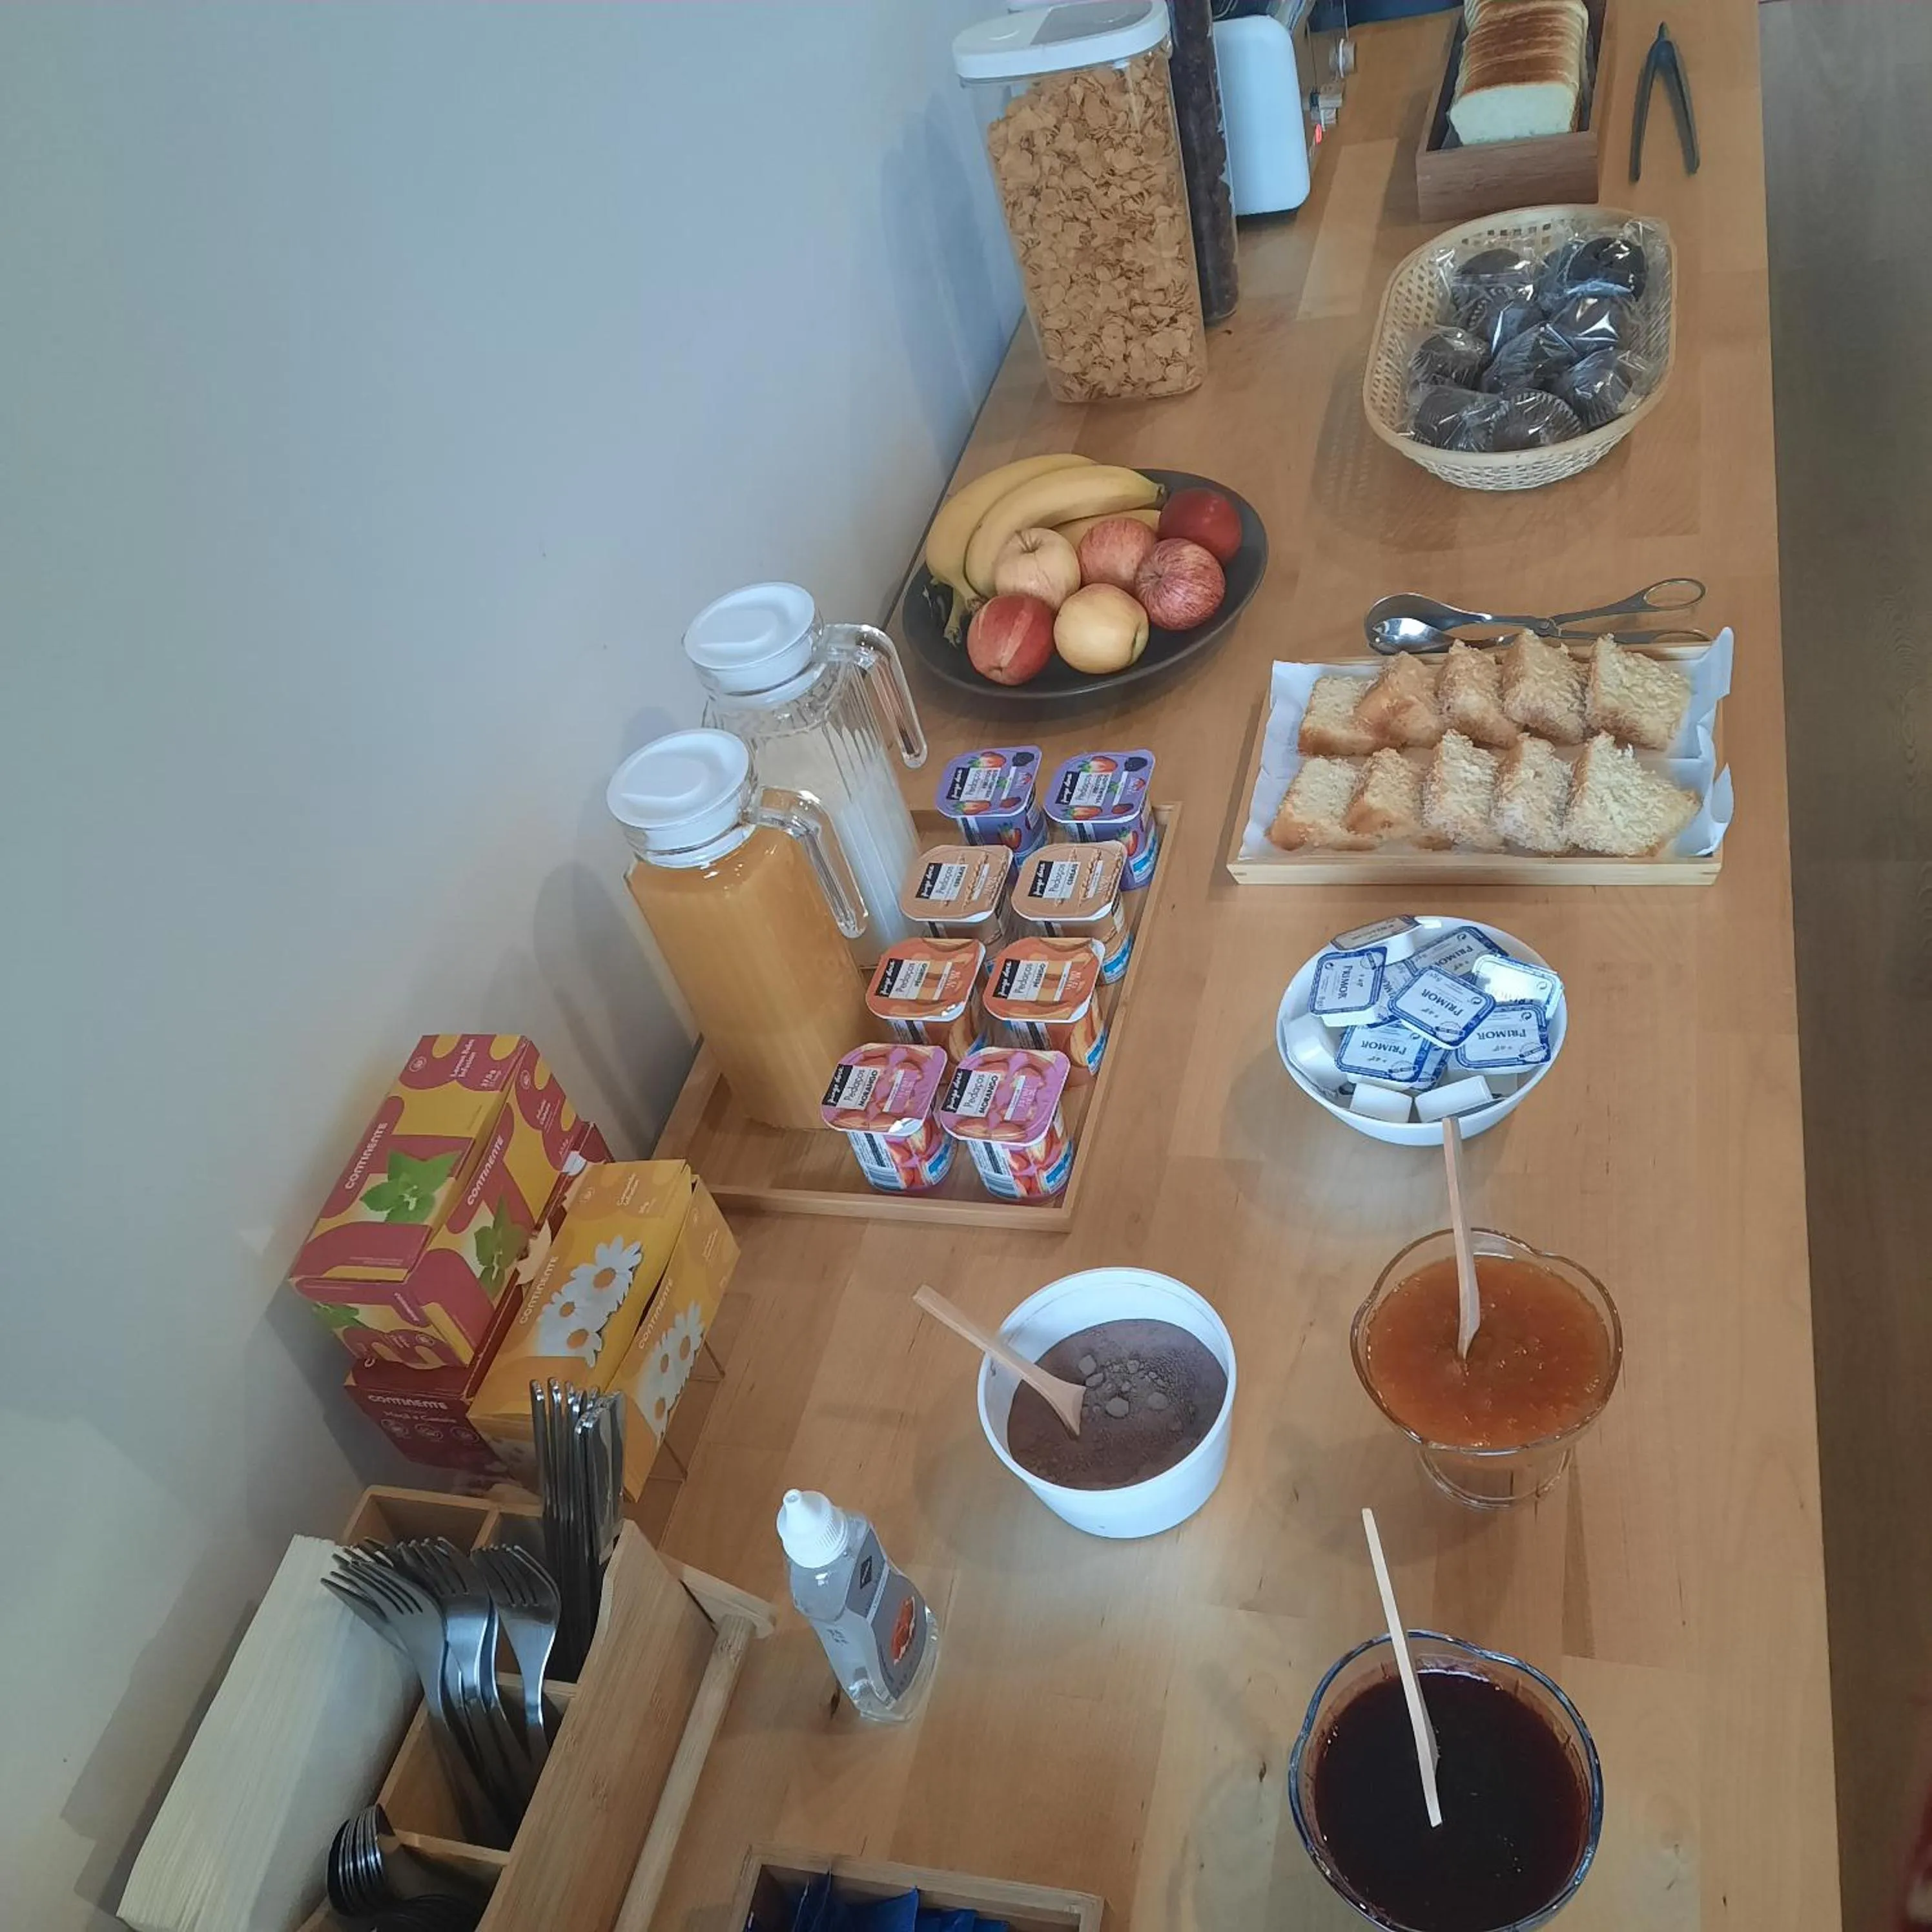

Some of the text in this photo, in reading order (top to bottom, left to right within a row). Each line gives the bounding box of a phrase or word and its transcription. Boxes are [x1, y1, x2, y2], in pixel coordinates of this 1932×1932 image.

[936, 866, 954, 894] Pedaços
[1048, 864, 1066, 892] Pedaços
[1434, 945, 1474, 970] PRIMO
[895, 963, 916, 992] Pedaços
[1014, 963, 1033, 994] Pedaços
[1338, 965, 1353, 1000] PRIMOR
[1421, 988, 1463, 1017] PRIMOR
[1360, 1040, 1408, 1055] PRIMOR
[1476, 1028, 1527, 1040] PRIMOR
[843, 1069, 865, 1102] Pedaços
[858, 1069, 878, 1107] MORANGO
[963, 1074, 985, 1108] Pedaços
[978, 1074, 999, 1114] MORANGO
[344, 1122, 388, 1189] CONTINENTE
[466, 1134, 504, 1206] CONTINENTE
[519, 1256, 559, 1324] CONTINENTE
[638, 1277, 673, 1350] CONTINENTE
[367, 1394, 448, 1410] CONTINENTE
